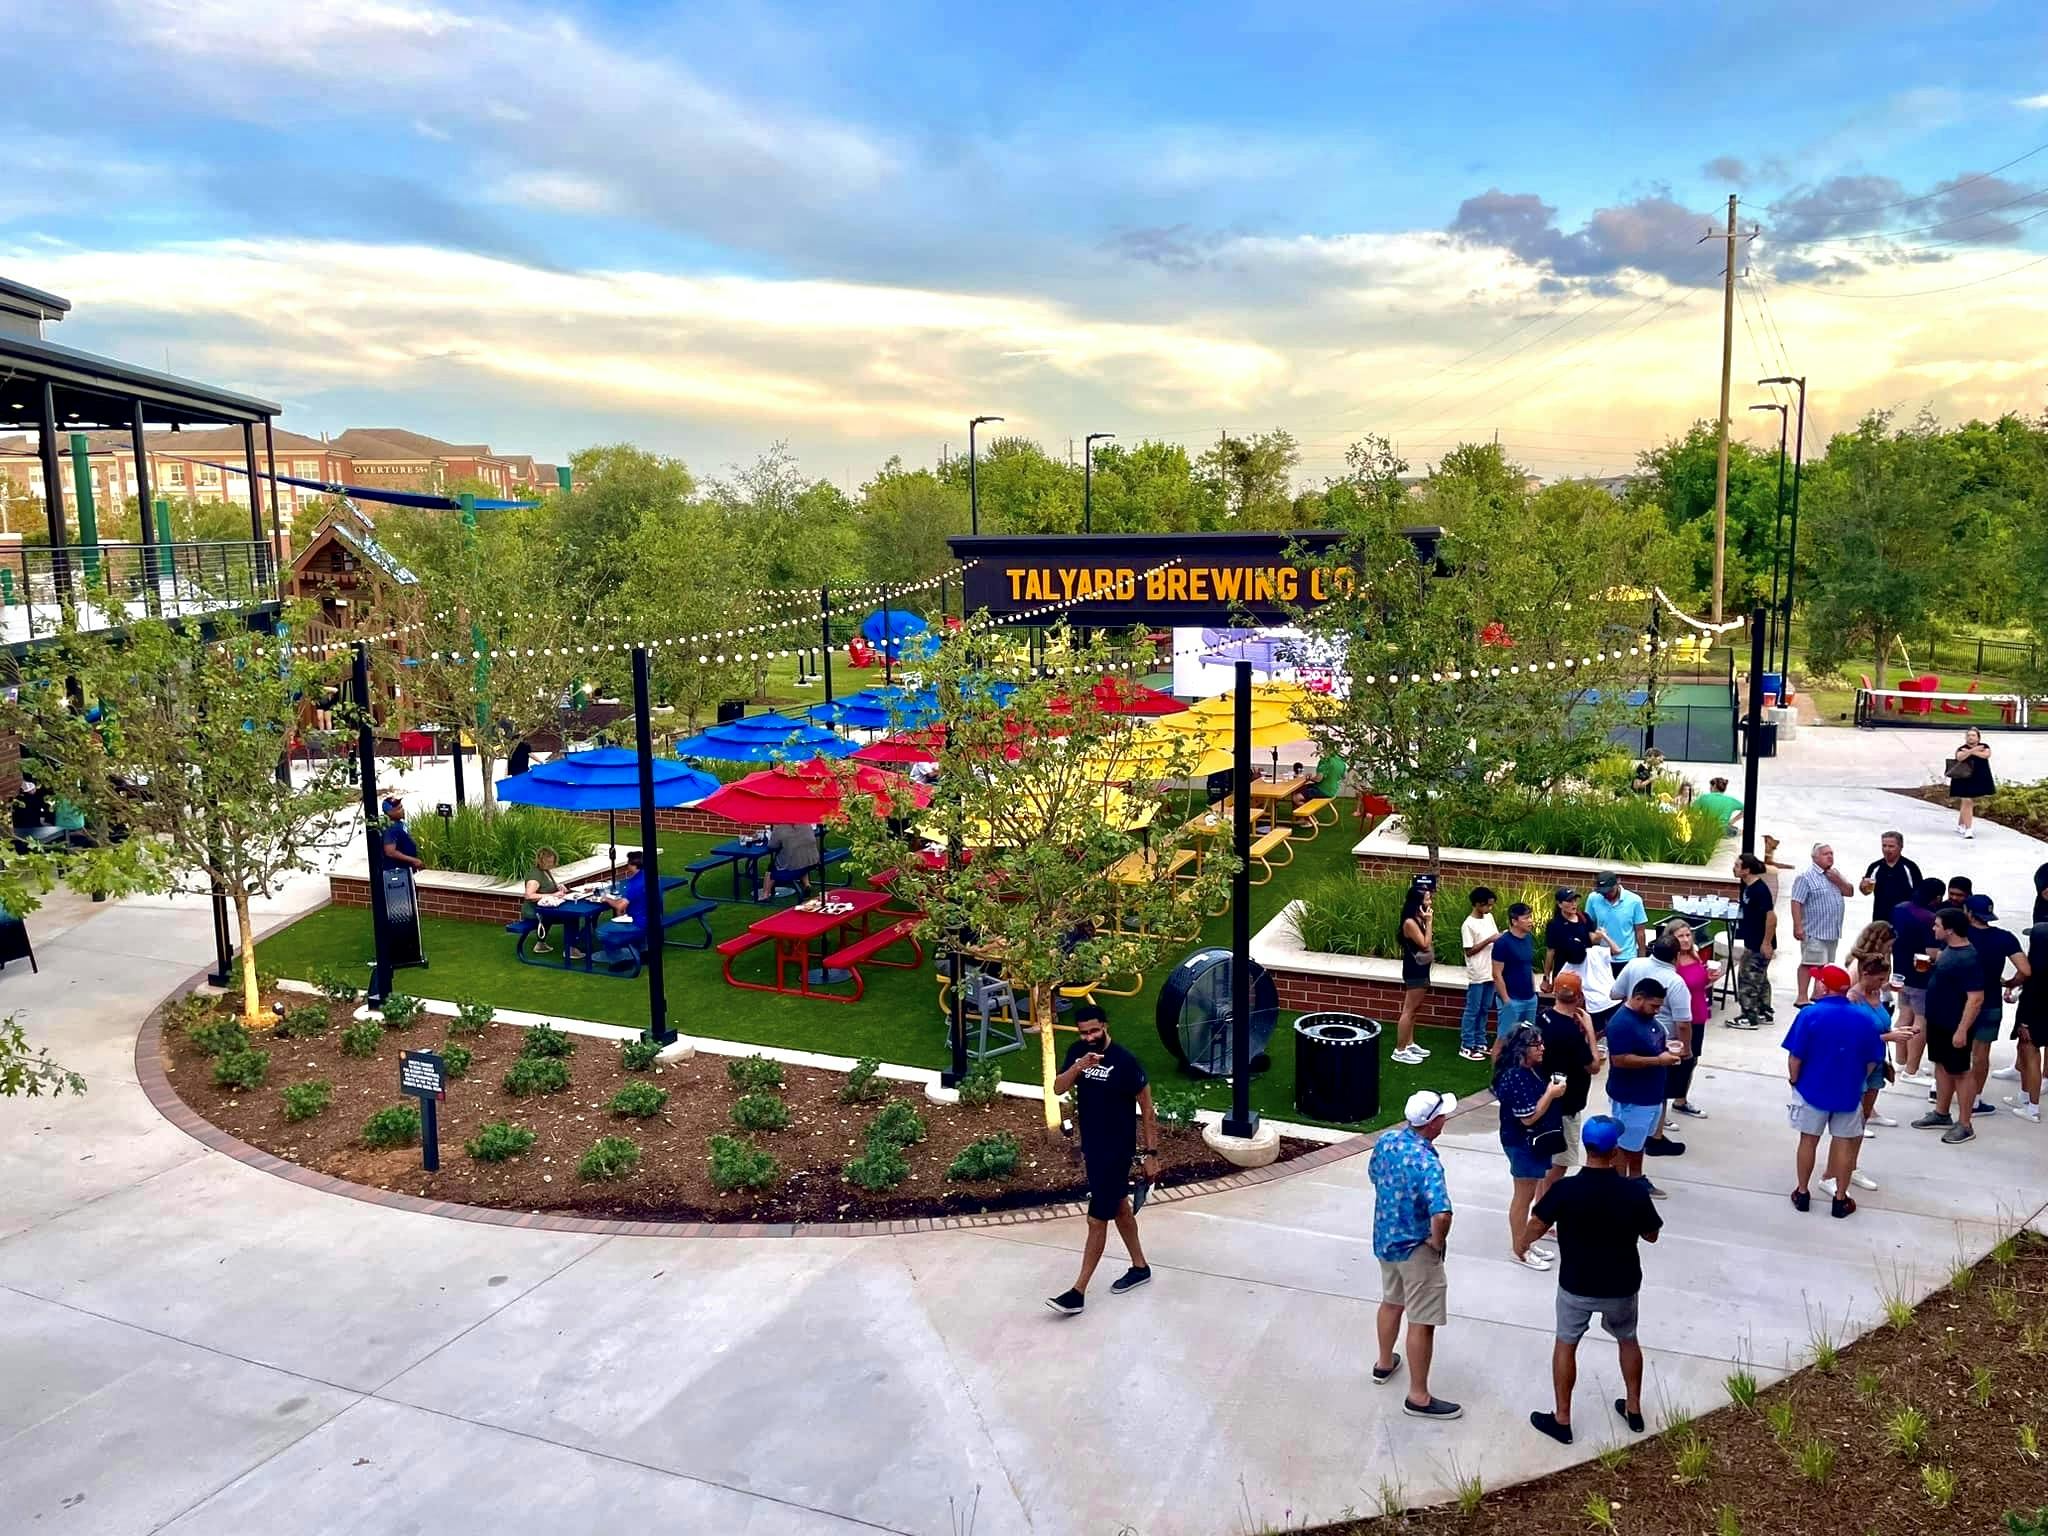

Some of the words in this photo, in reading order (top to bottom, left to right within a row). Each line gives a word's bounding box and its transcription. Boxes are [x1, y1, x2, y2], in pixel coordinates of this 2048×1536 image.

[354, 466, 413, 474] OVERTURE
[1007, 568, 1135, 600] TALYARD
[1147, 567, 1298, 601] BREWING
